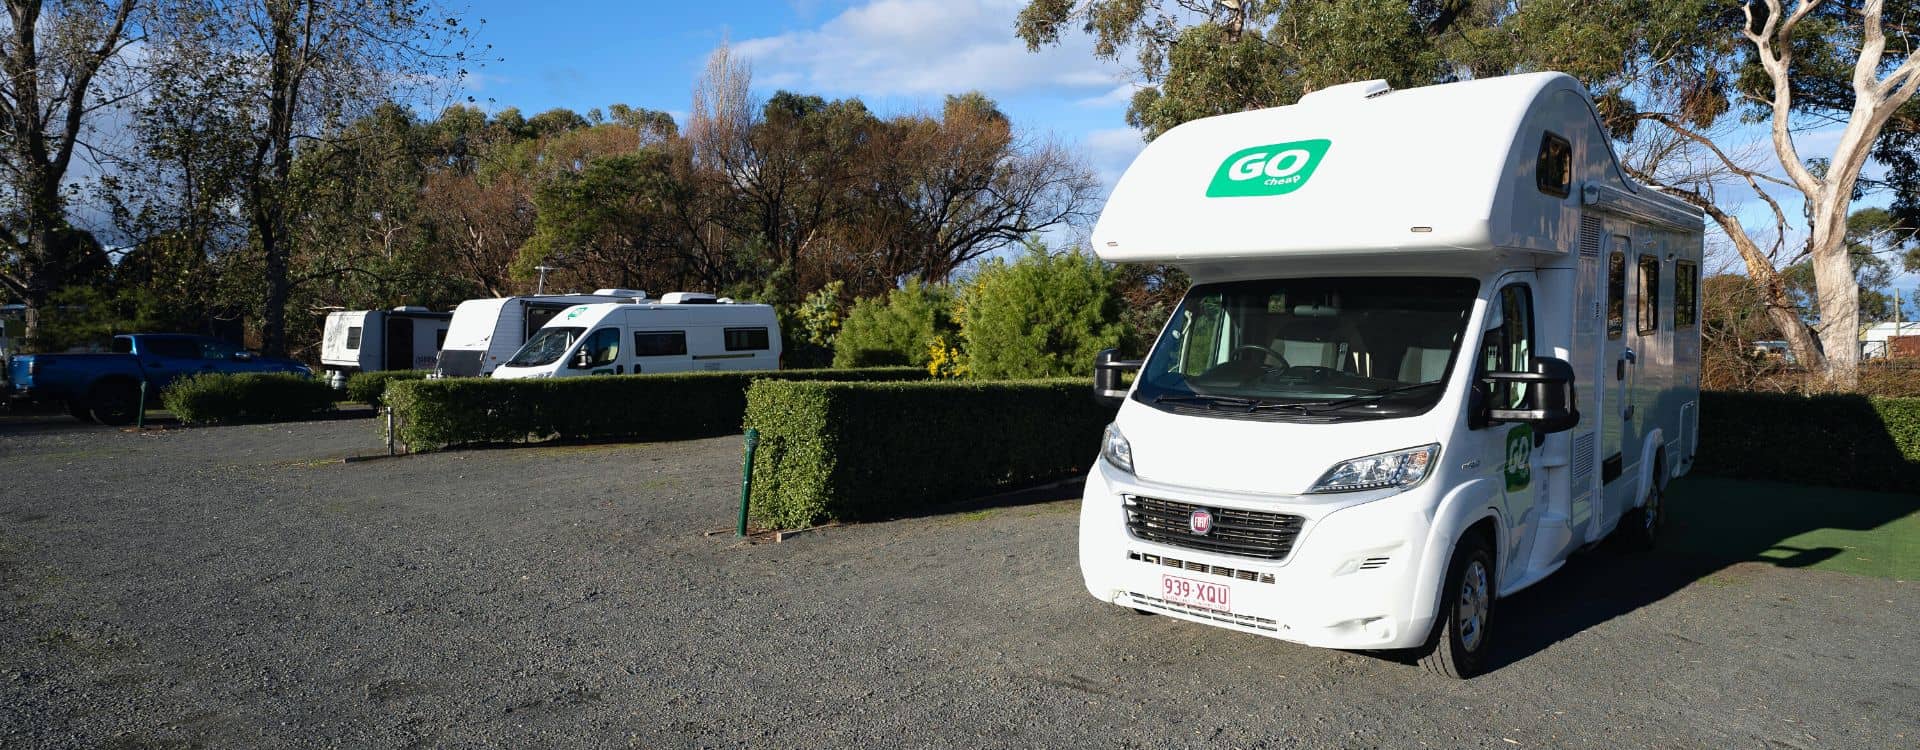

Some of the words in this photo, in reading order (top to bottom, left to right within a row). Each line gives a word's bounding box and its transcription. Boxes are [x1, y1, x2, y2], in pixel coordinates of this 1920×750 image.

[1229, 149, 1310, 181] GO
[1264, 175, 1301, 186] cheap
[1509, 437, 1528, 473] GO
